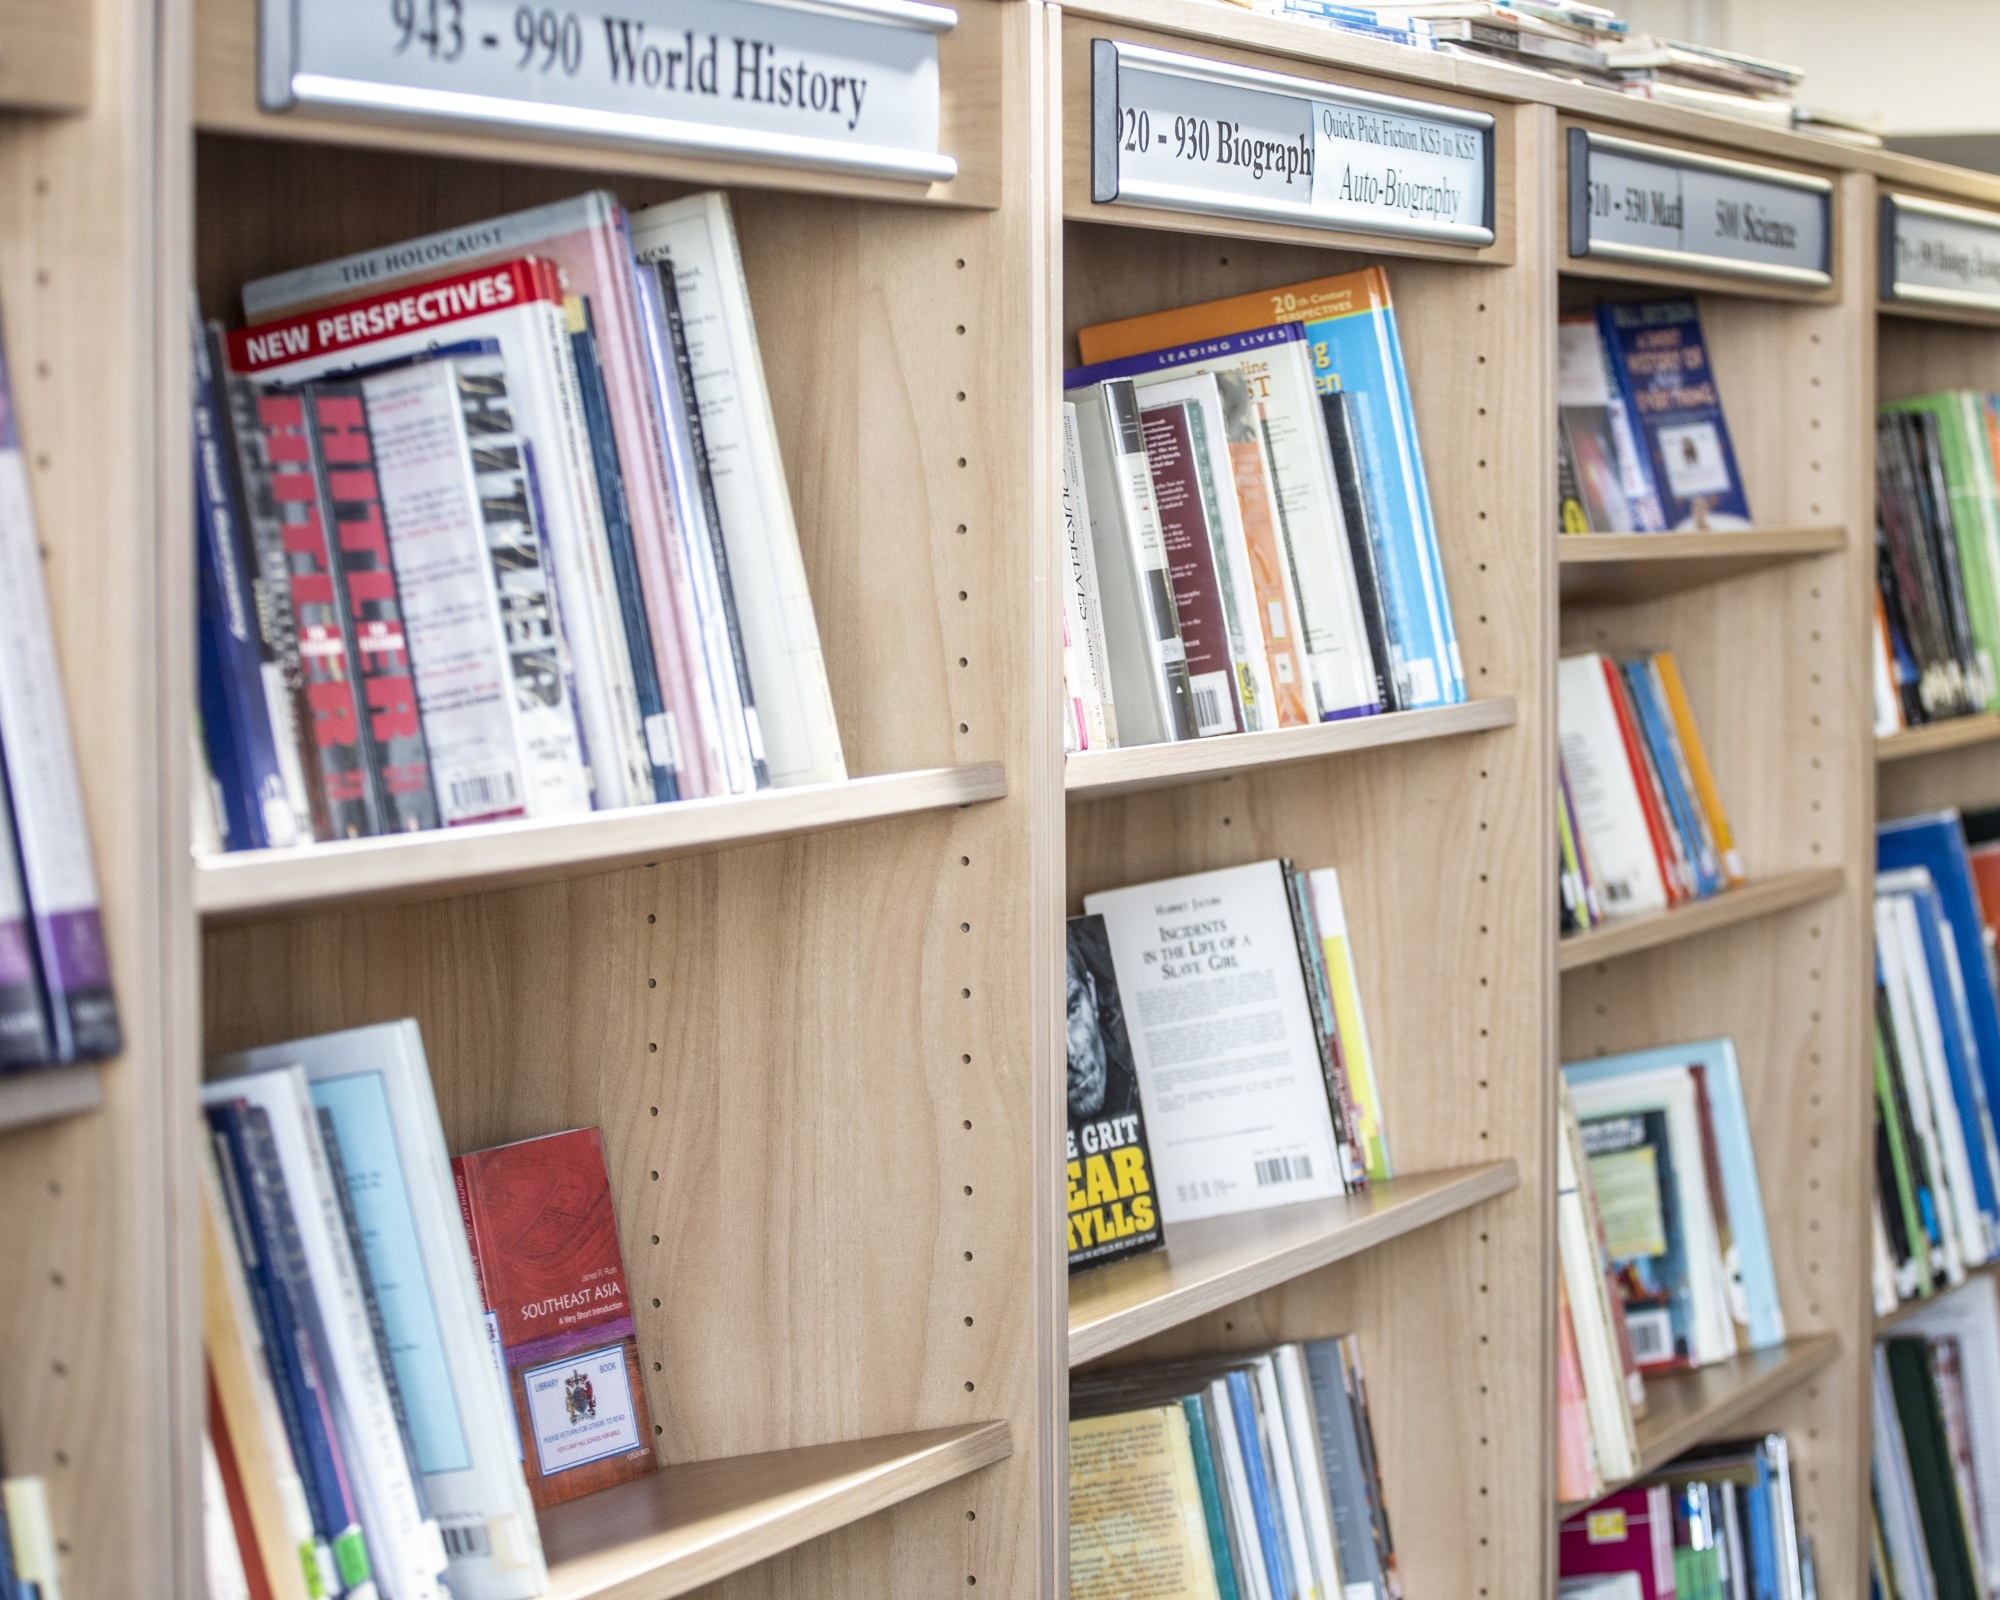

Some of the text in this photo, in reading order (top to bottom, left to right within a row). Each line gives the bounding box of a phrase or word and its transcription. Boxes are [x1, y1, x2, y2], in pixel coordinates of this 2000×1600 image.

[514, 8, 581, 77] 990
[602, 18, 719, 96] World
[732, 38, 867, 130] History
[1323, 109, 1354, 143] Quick
[1357, 115, 1380, 145] Pick
[1382, 120, 1417, 151] Fiction
[1174, 116, 1210, 161] 930
[1217, 120, 1315, 184] Biograph
[1339, 162, 1461, 223] Auto-Biography
[1743, 202, 1797, 249] Science
[340, 226, 503, 284] THE HOLOCAUST
[1275, 300, 1354, 324] PERSPECTIVES
[1310, 289, 1353, 304] Century
[246, 270, 514, 365] NEW PERSPECTIVES
[1158, 329, 1287, 364] LEADING LIVES
[257, 396, 360, 744] HITLER
[317, 396, 419, 740] HITLER
[1158, 919, 1228, 943] INCIDENTS
[1160, 943, 1185, 961] THE
[1188, 939, 1217, 956] LIFE
[1220, 935, 1236, 950] OF
[1160, 954, 1239, 980] SLAVE GIRL
[1081, 1113, 1138, 1154] GRIT
[582, 1272, 598, 1282] James
[604, 1266, 618, 1275] Rush
[521, 1281, 621, 1320] SOUTHEAST ASIA
[564, 1315, 577, 1324] Very
[576, 1309, 592, 1321] Short
[592, 1301, 624, 1316] Introduction
[599, 1361, 617, 1374] BOOK
[535, 1379, 559, 1393] LIBRARY
[543, 1433, 560, 1444] PLEASE
[560, 1428, 578, 1440] RETURN
[578, 1425, 588, 1435] FOR
[588, 1421, 606, 1431] OTHERS
[612, 1414, 626, 1423] READ
[627, 1447, 650, 1461] OXFORD
